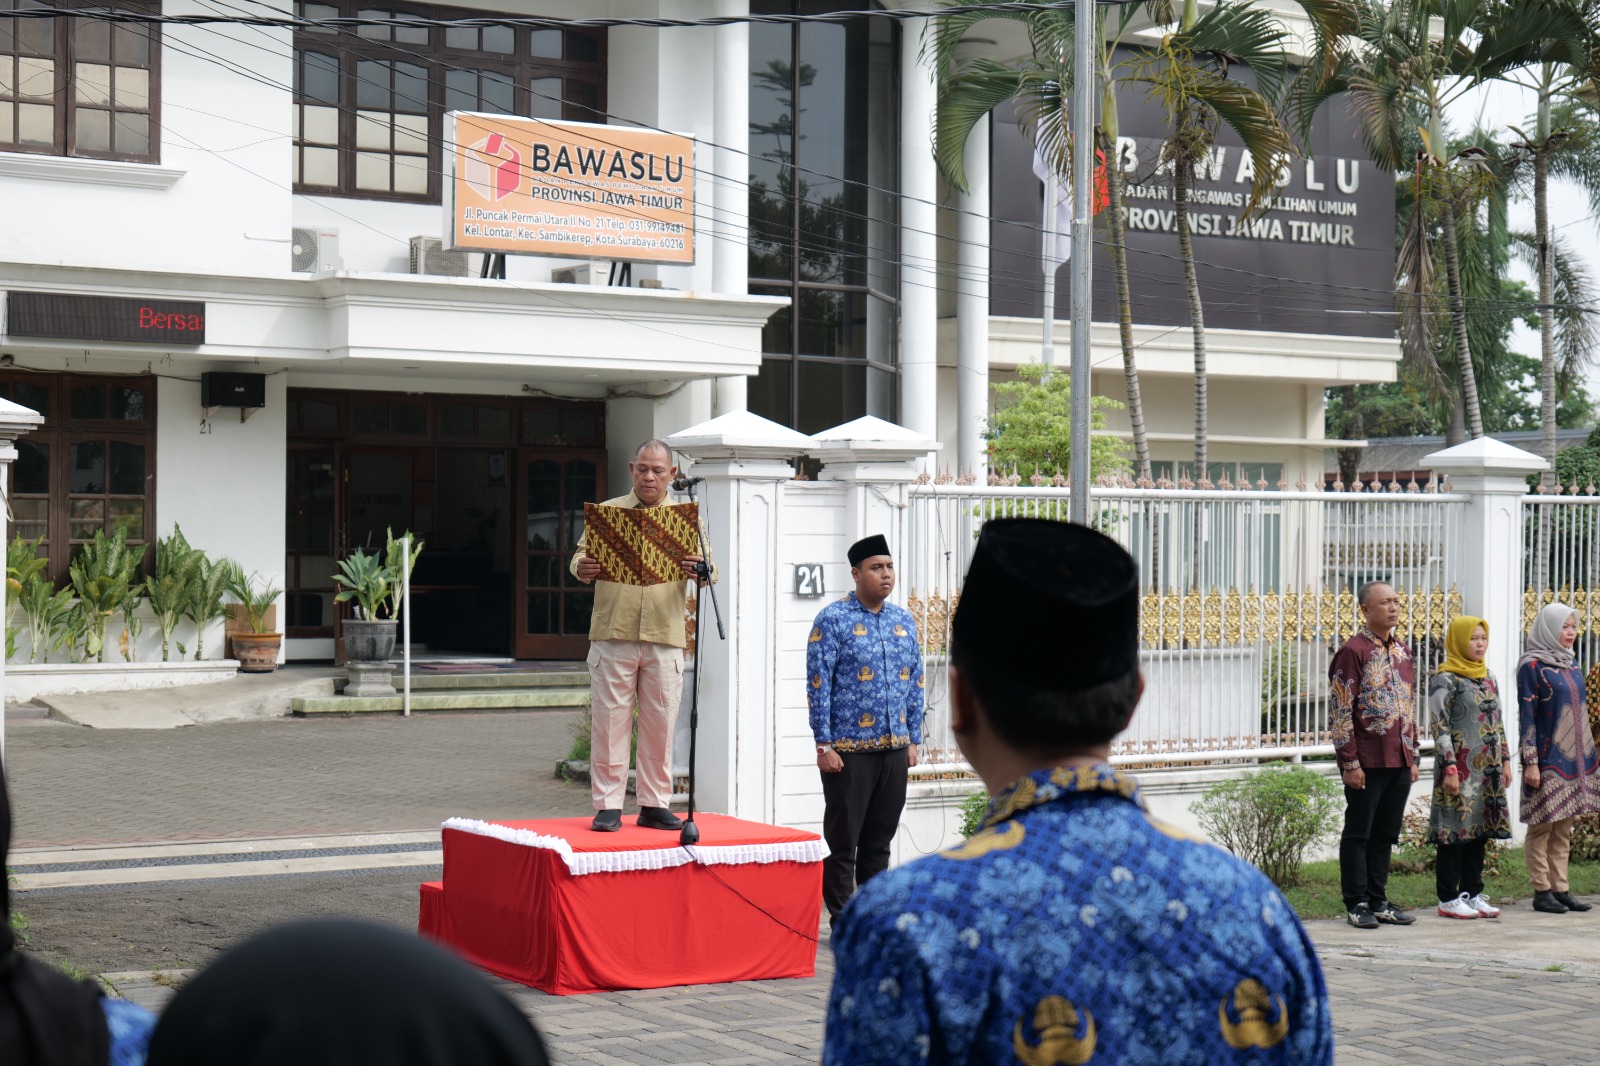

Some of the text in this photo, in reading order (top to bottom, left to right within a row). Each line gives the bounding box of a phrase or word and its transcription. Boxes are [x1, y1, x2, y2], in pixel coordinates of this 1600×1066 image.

[532, 143, 683, 183] BAWASLU
[563, 179, 610, 188] PENGAWAS
[531, 186, 683, 209] PROVINSI JAWA TIMUR
[1120, 184, 1168, 200] ADAN
[1318, 200, 1357, 216] UMUM
[464, 208, 474, 219] Jl.
[476, 209, 509, 222] Puncak
[511, 212, 542, 224] Permai
[544, 214, 568, 225] Utara
[578, 217, 593, 227] No.
[595, 218, 604, 228] 21
[606, 219, 627, 231] Telp.
[1225, 215, 1284, 240] JAWA
[1288, 220, 1354, 245] TIMUR
[465, 225, 684, 249] Kel. Lontar, Kec. Sambikerep, Kota Surabaya-60216
[798, 565, 822, 594] 21
